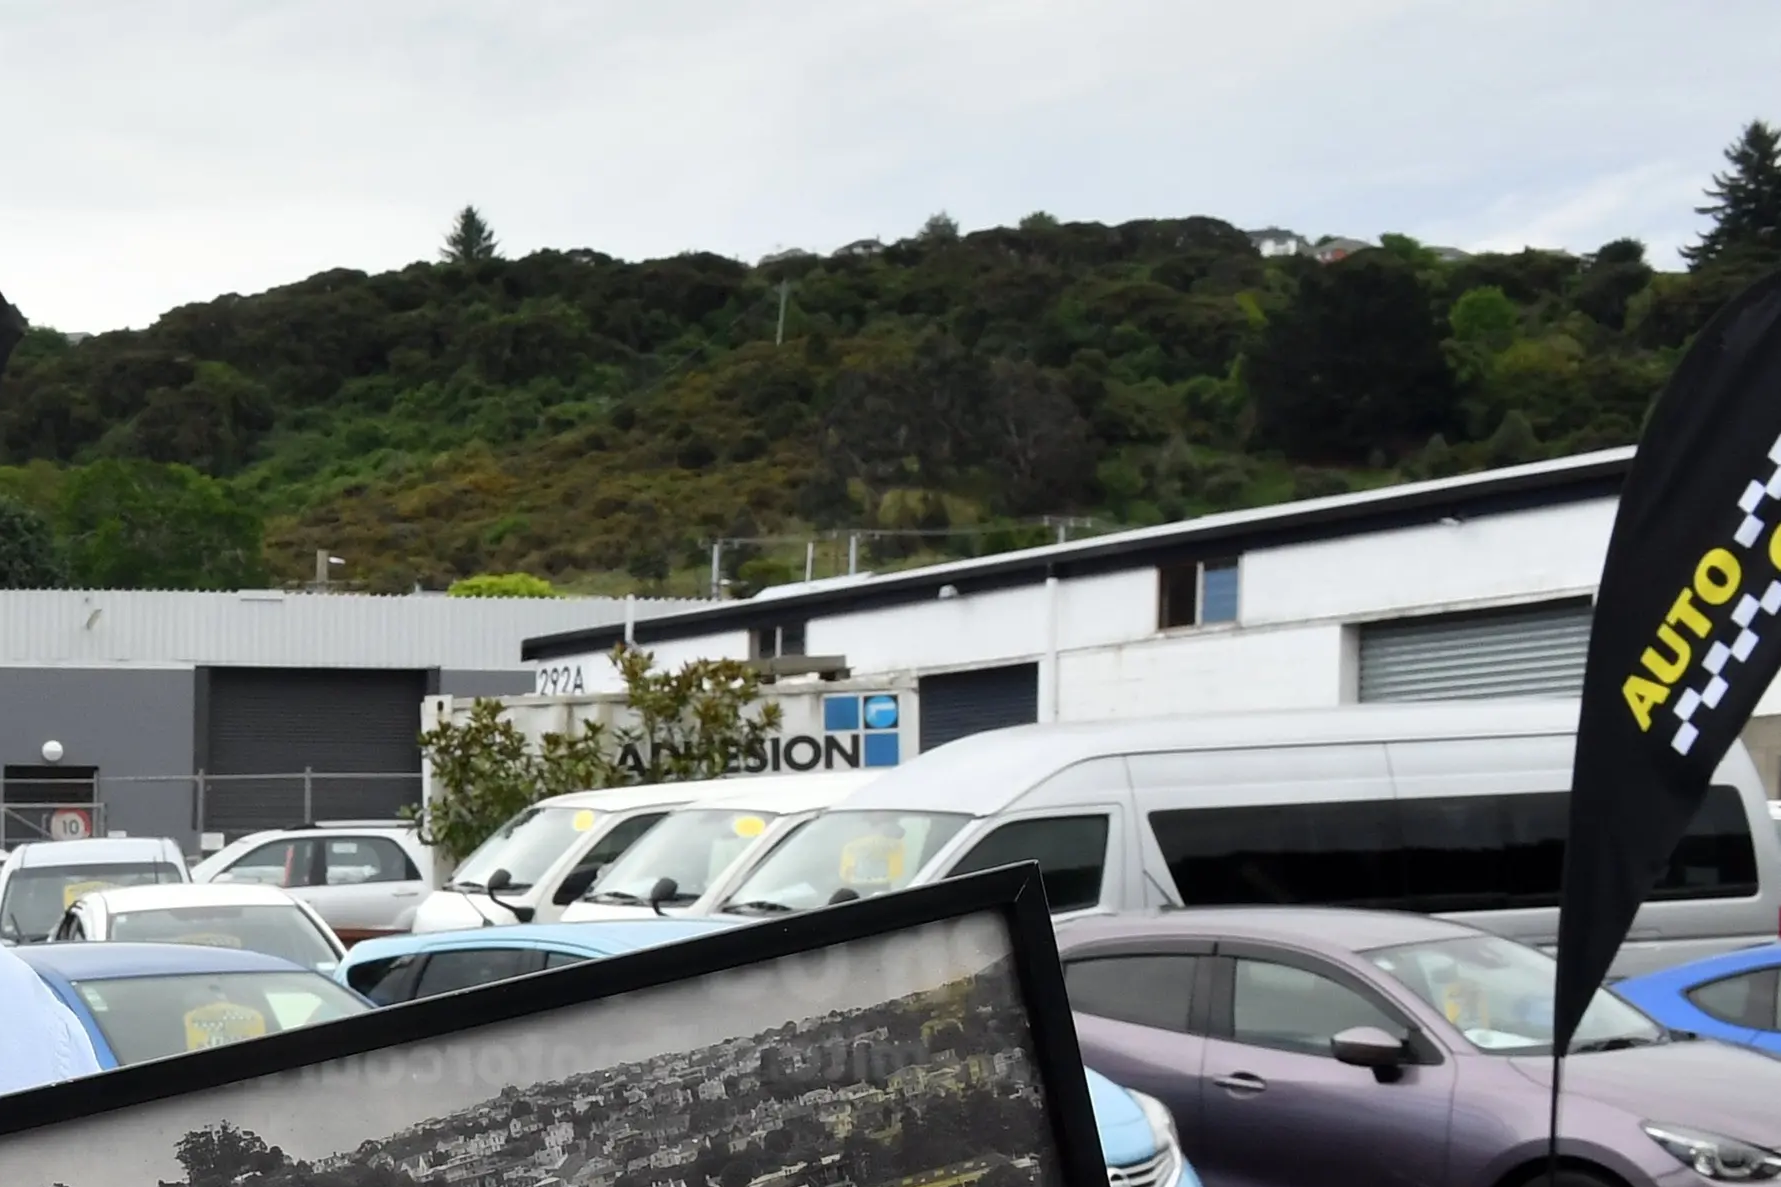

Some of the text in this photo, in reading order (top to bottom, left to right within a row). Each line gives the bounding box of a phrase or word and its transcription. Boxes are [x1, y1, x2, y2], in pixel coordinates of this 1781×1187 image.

[1622, 547, 1742, 732] AUTO
[539, 665, 584, 696] 292A
[62, 818, 80, 836] 10
